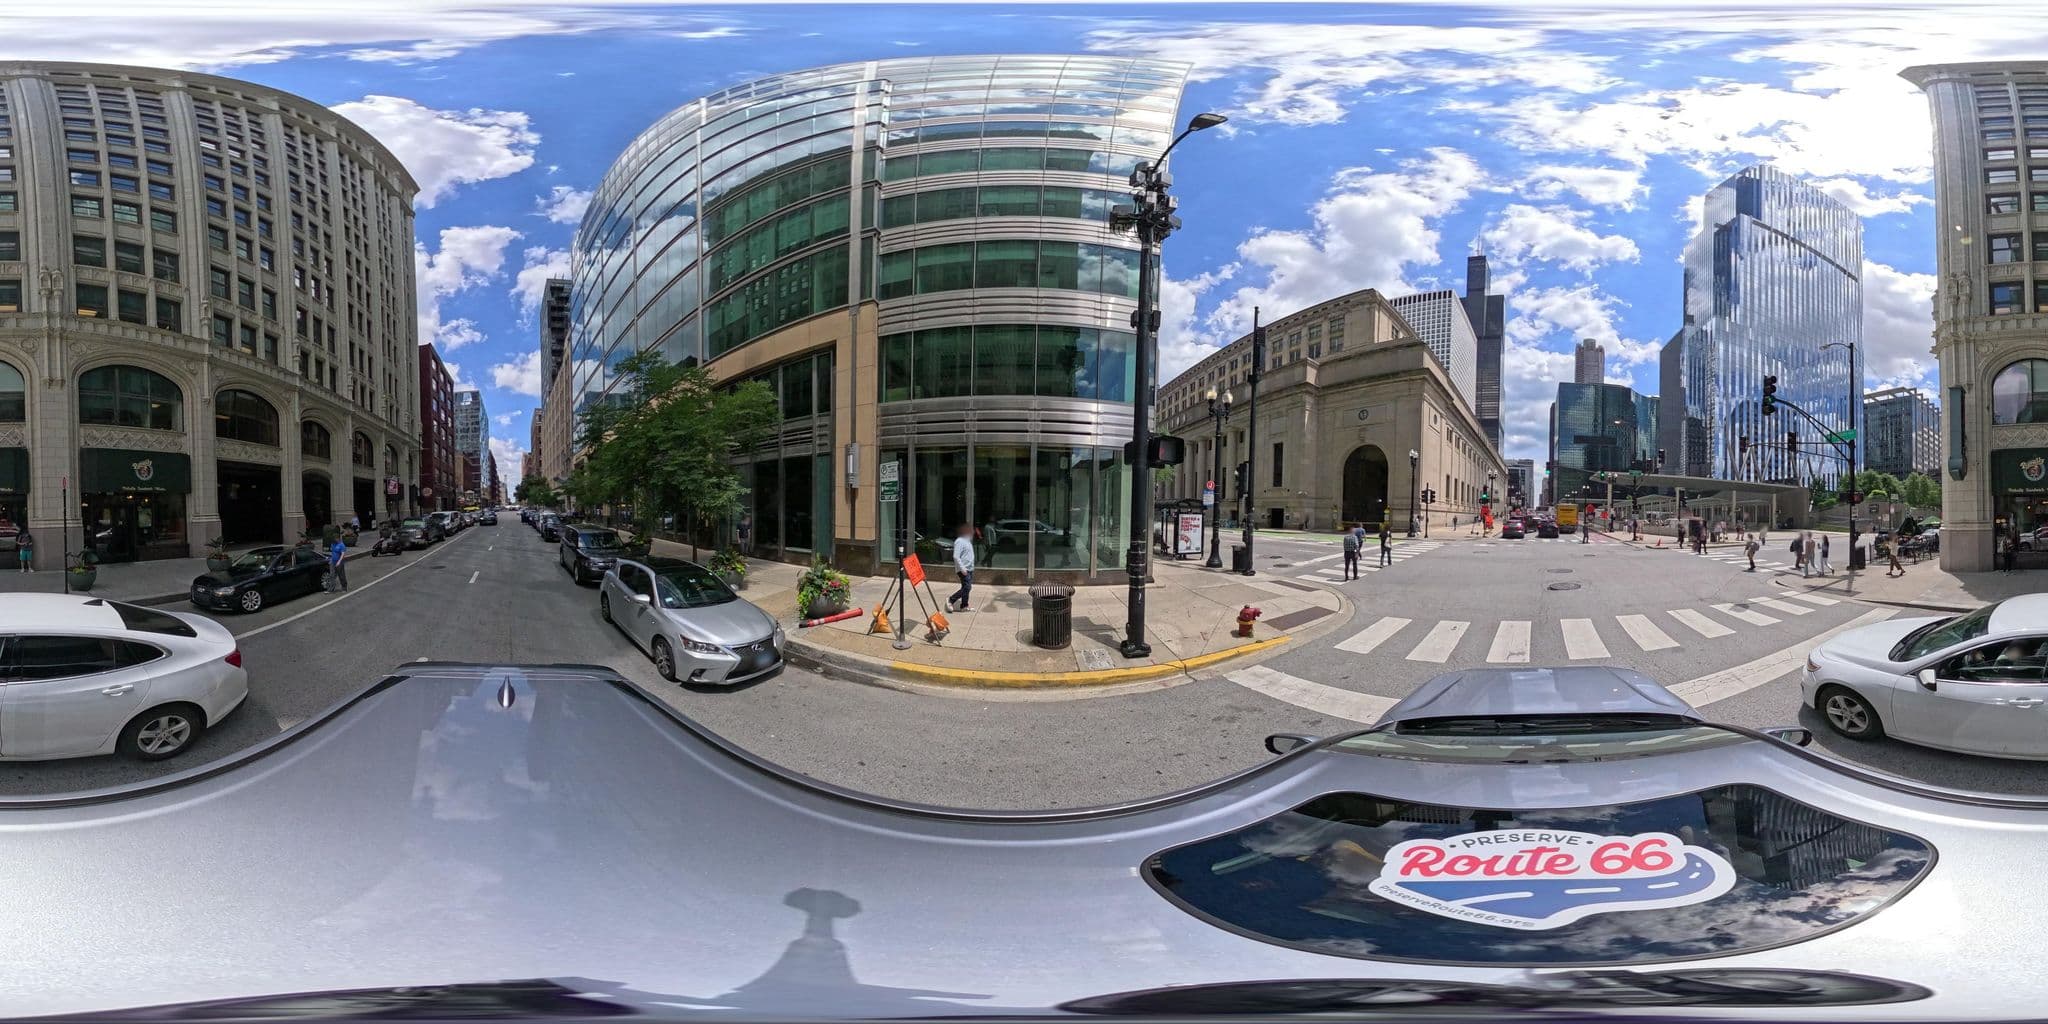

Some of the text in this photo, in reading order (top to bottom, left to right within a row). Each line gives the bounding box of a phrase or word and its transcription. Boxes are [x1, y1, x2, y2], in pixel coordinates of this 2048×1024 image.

[1400, 839, 1674, 877] Route 66
[1462, 833, 1582, 848] PRESERVE
[1378, 885, 1536, 928] PreserveRoute66.org
